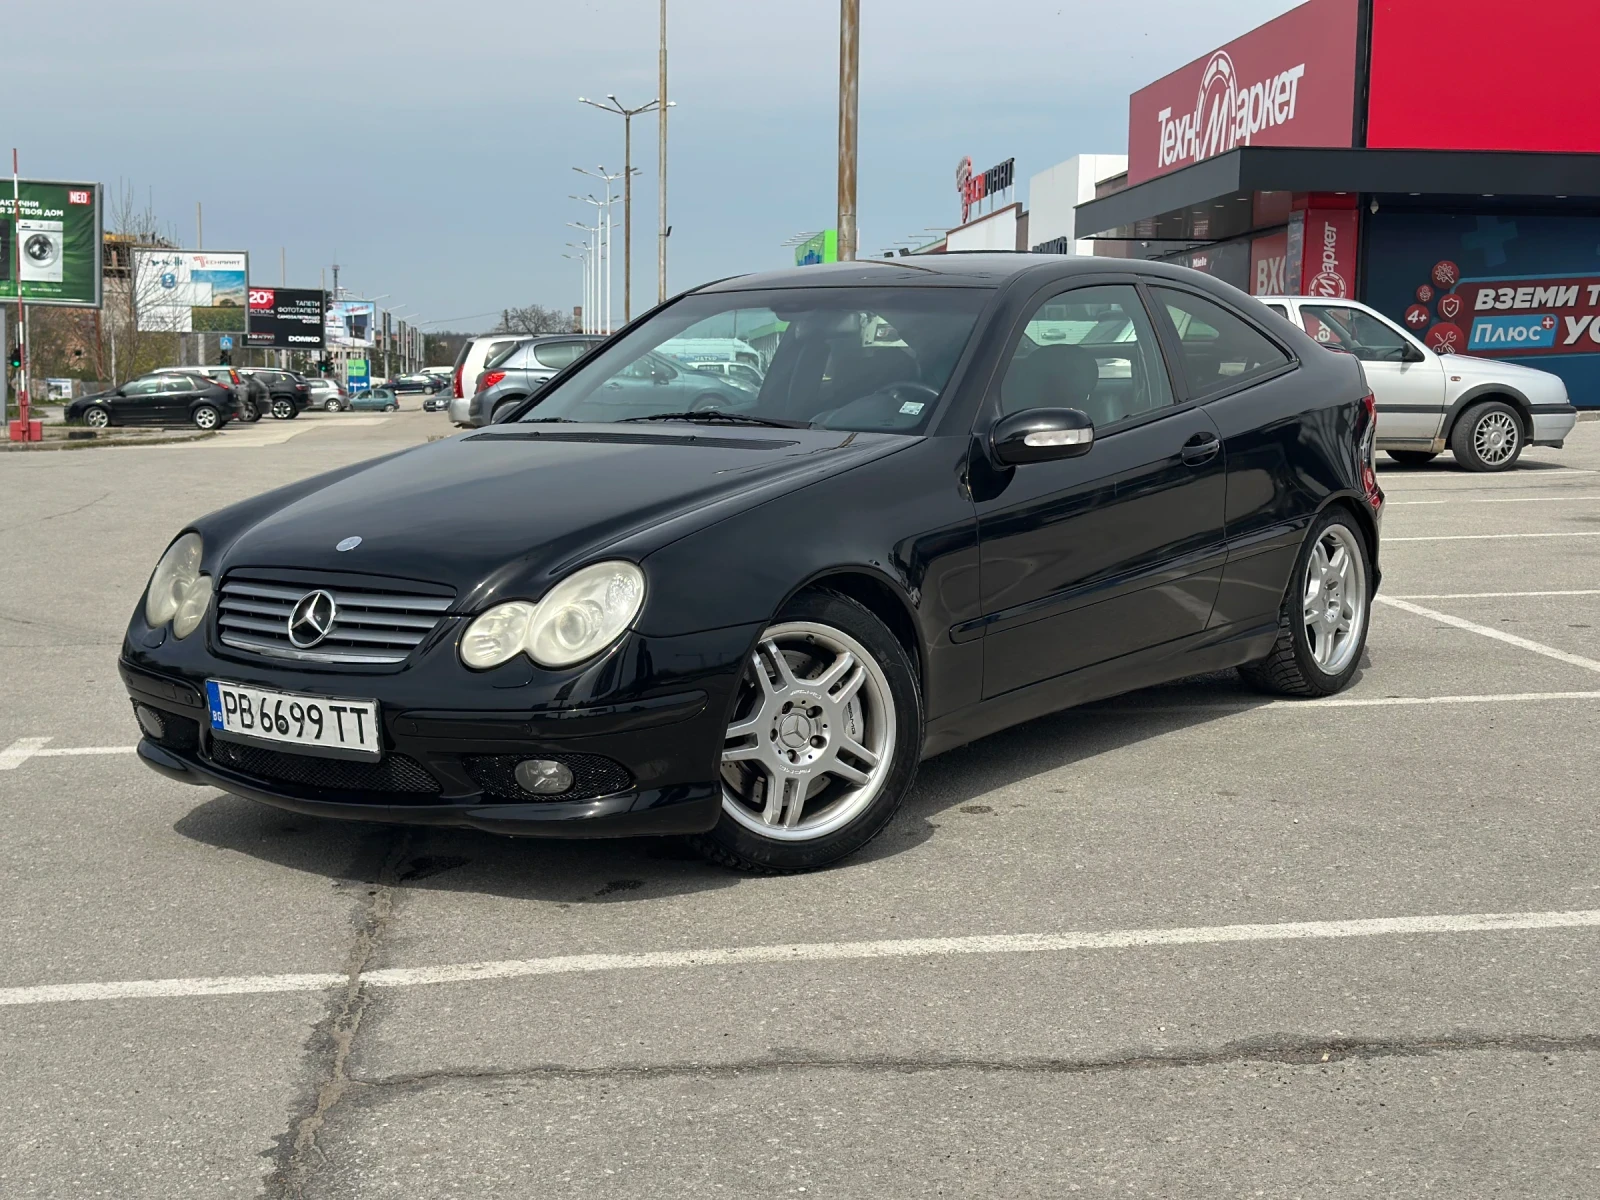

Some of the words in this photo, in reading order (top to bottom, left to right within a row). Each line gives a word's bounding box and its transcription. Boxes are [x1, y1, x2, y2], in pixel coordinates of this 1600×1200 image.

[70, 192, 87, 204] NEO
[1193, 257, 1207, 268] Miele
[1474, 285, 1579, 311] ВЗЕМИ
[1407, 310, 1427, 323] 4+
[213, 710, 222, 722] BG
